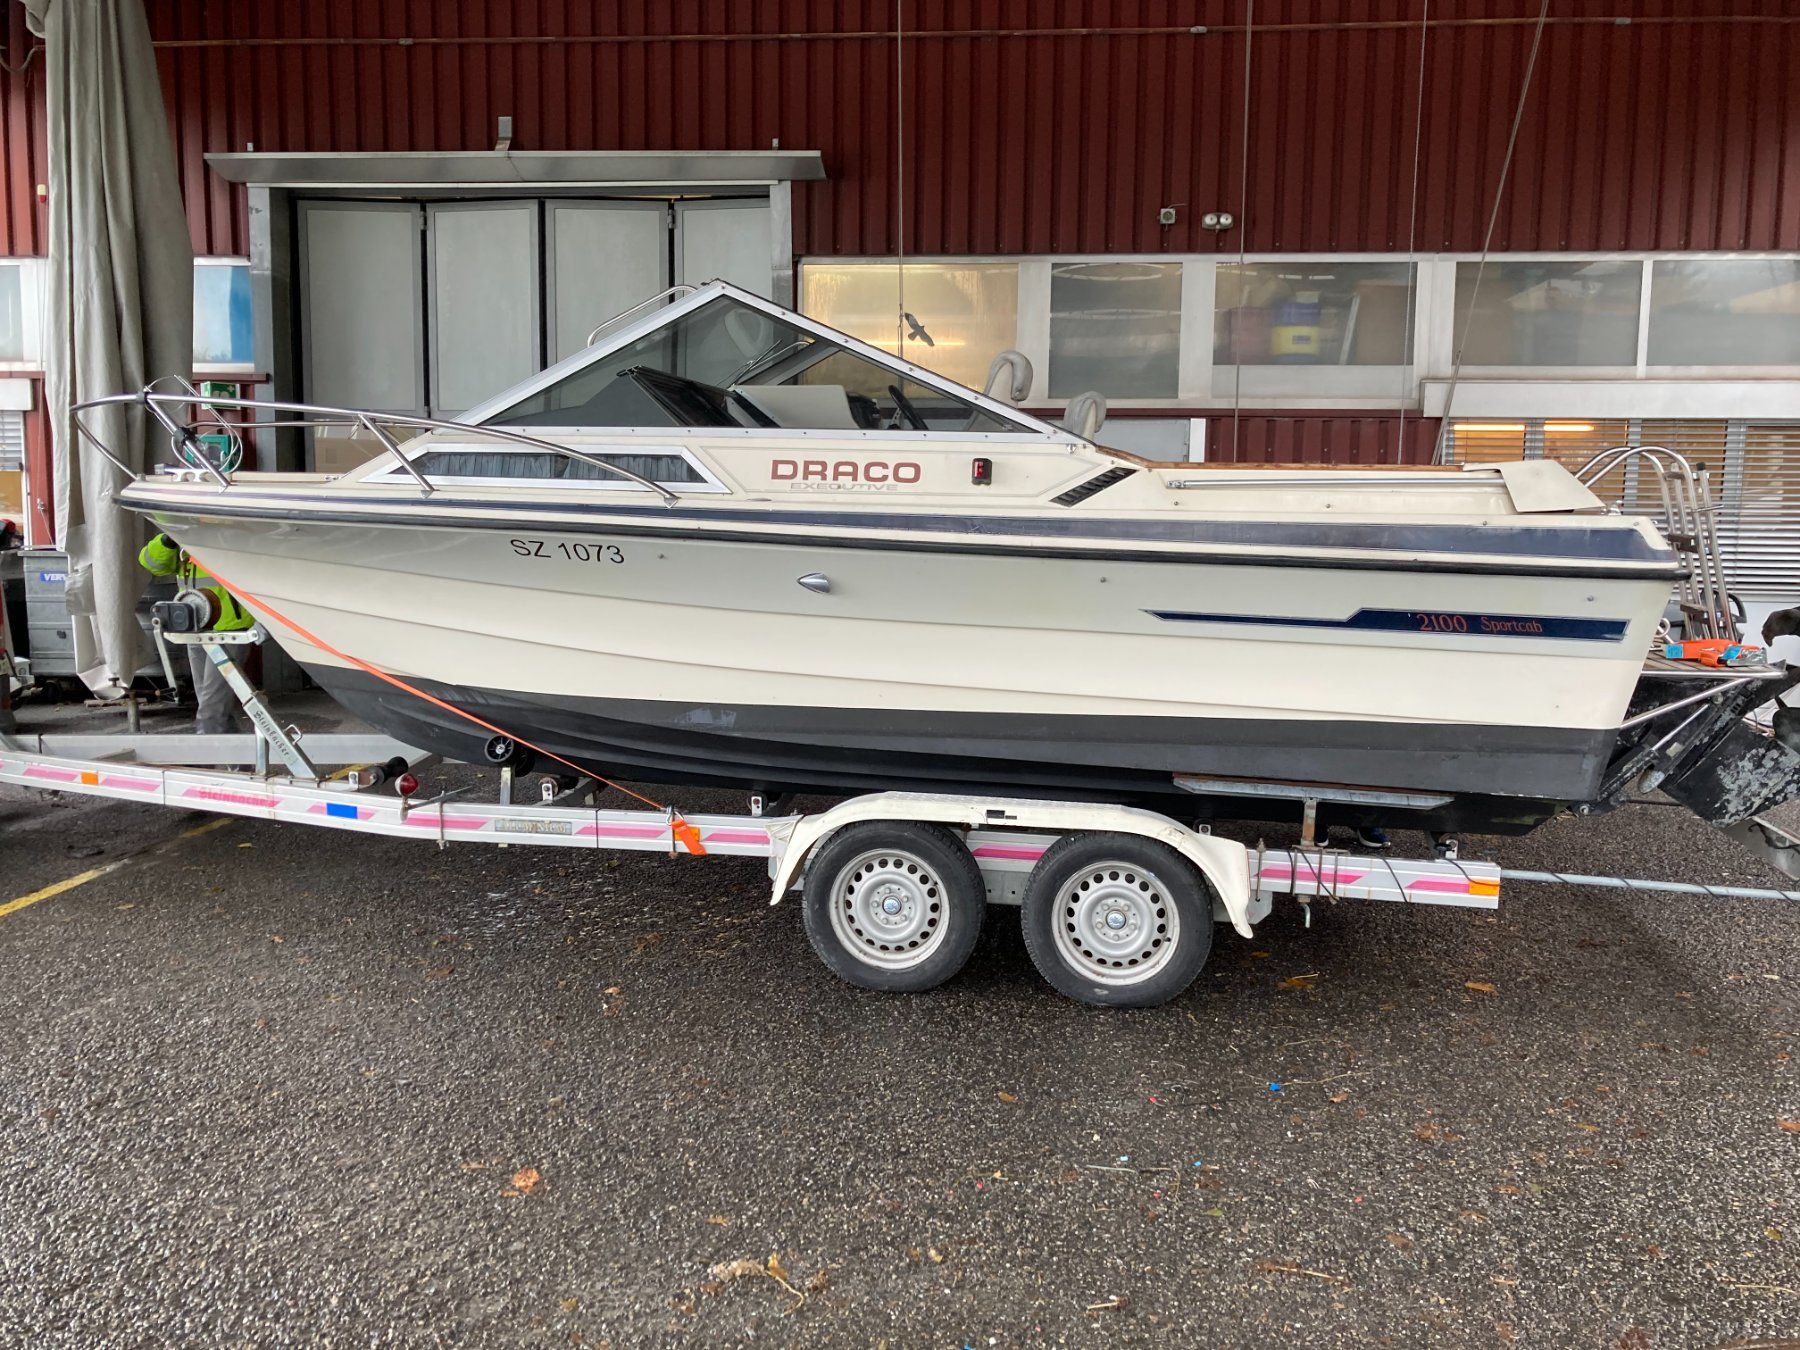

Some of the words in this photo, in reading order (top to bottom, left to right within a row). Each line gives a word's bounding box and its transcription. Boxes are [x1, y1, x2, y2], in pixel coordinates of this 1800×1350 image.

[771, 459, 921, 484] DRACO
[510, 539, 551, 558] SZ
[558, 542, 625, 564] 1073
[1416, 613, 1467, 632] 2100
[1481, 616, 1543, 633] Sportcab
